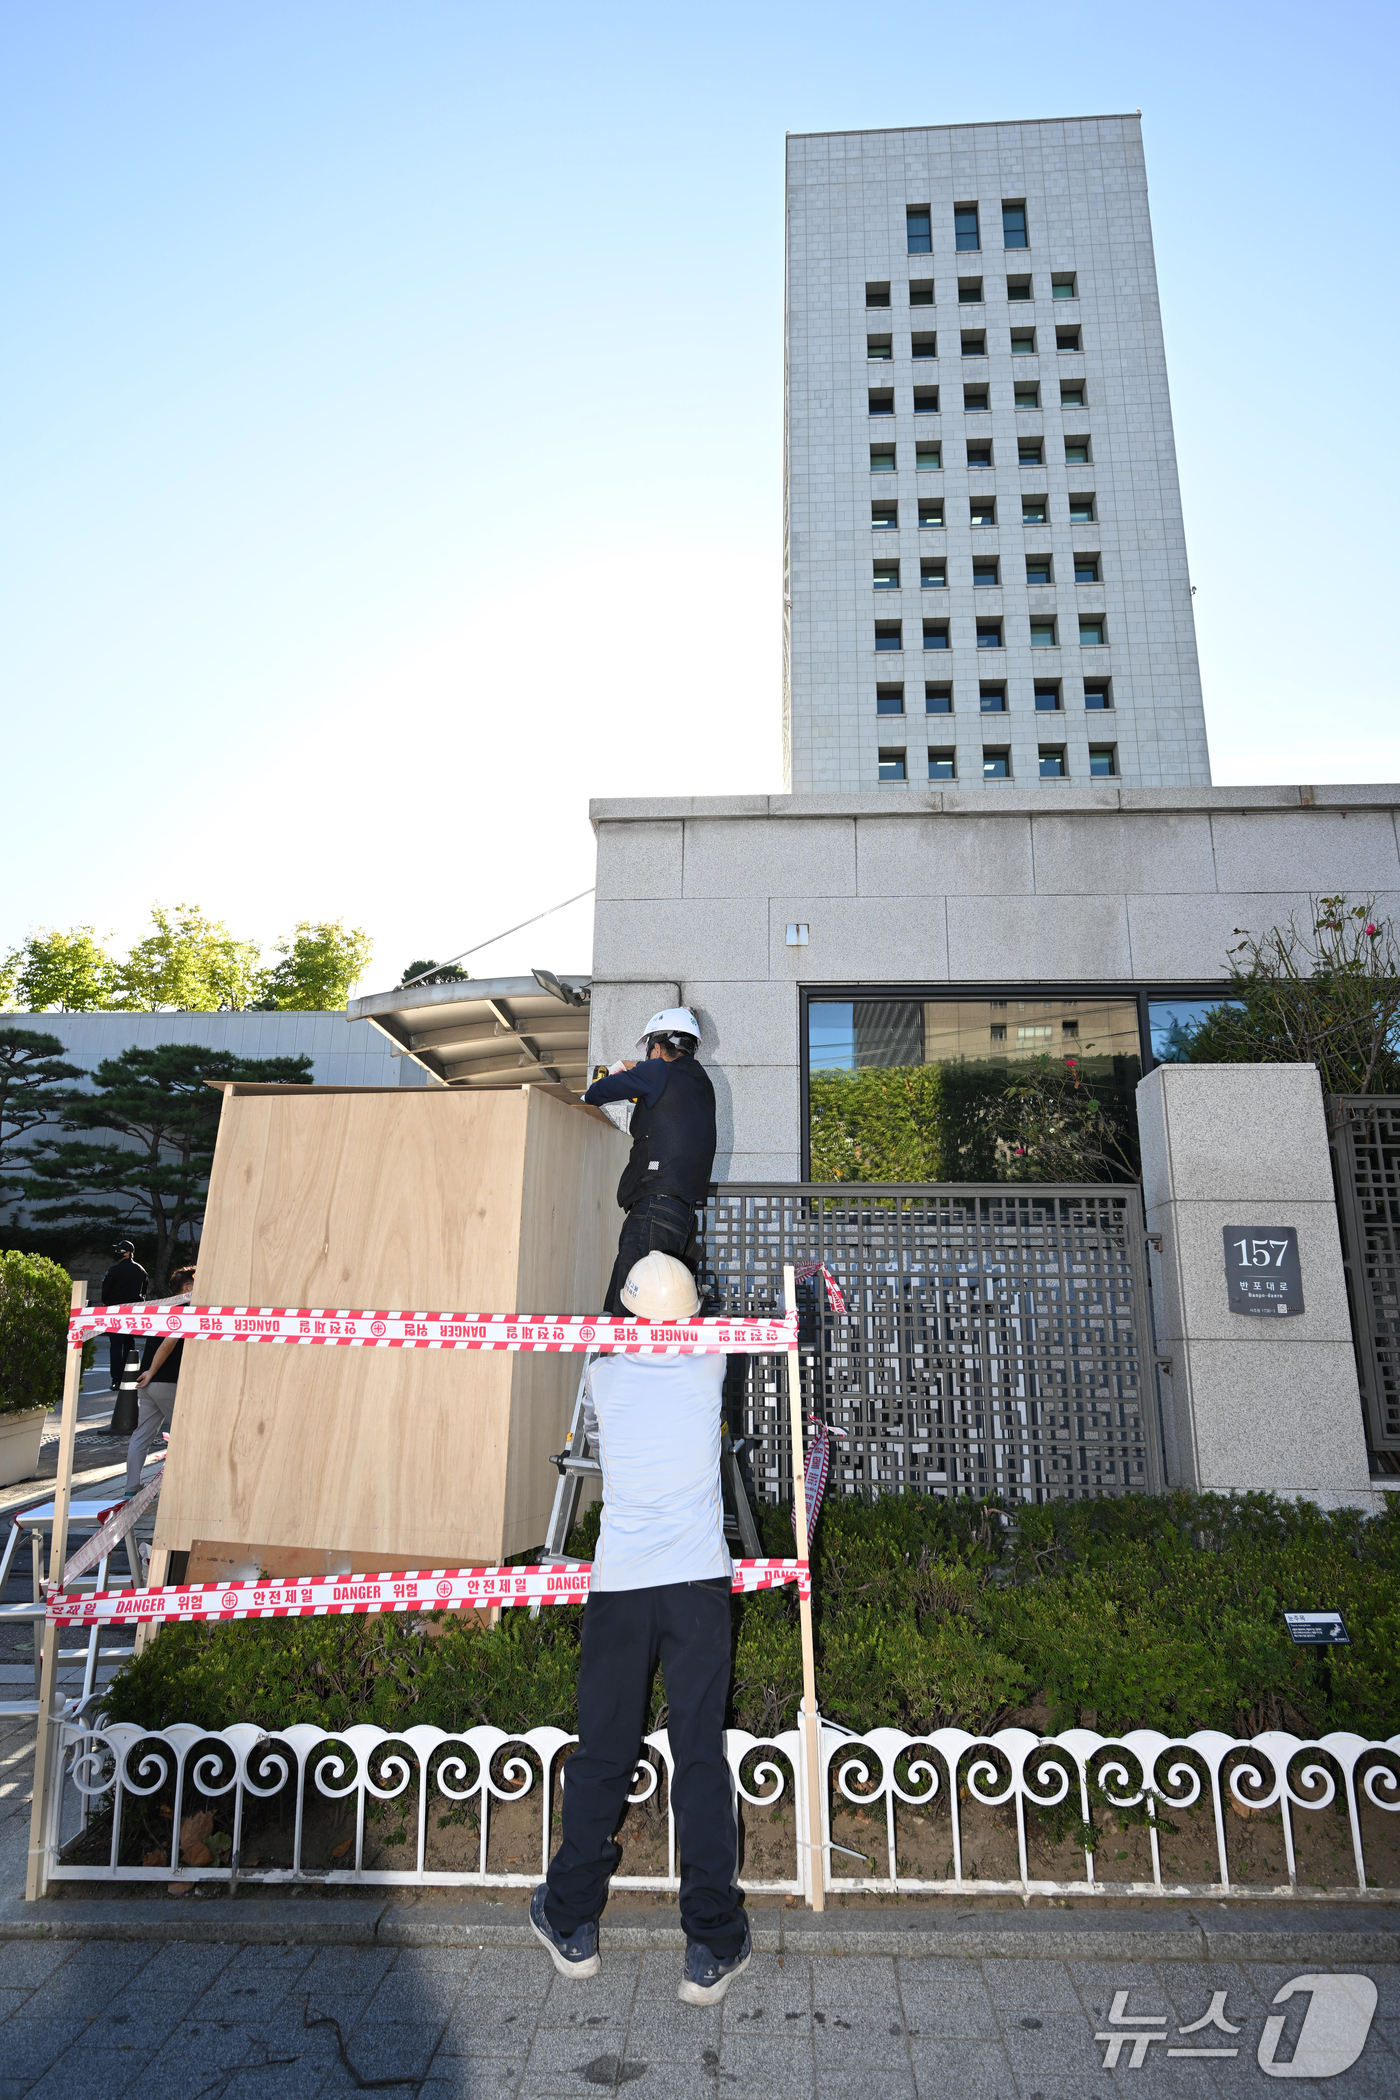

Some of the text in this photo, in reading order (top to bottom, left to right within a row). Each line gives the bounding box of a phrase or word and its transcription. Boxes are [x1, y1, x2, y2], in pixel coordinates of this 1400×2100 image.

[1233, 1239, 1288, 1267] 157
[1240, 1281, 1288, 1291] 반포대로
[200, 1317, 223, 1331] 위험
[234, 1319, 280, 1333] DANGER
[299, 1320, 356, 1335] 안전제일
[405, 1322, 428, 1337] 위험
[440, 1325, 486, 1339] DANGER
[507, 1326, 564, 1341] 안전제일
[614, 1328, 638, 1342] 위험
[650, 1328, 698, 1342] DANGER
[719, 1328, 779, 1342] 안전제일
[46, 1575, 592, 1616] 전제일 DANGER 위험 안전제일 DANGER 위험 안전제일 DANGE
